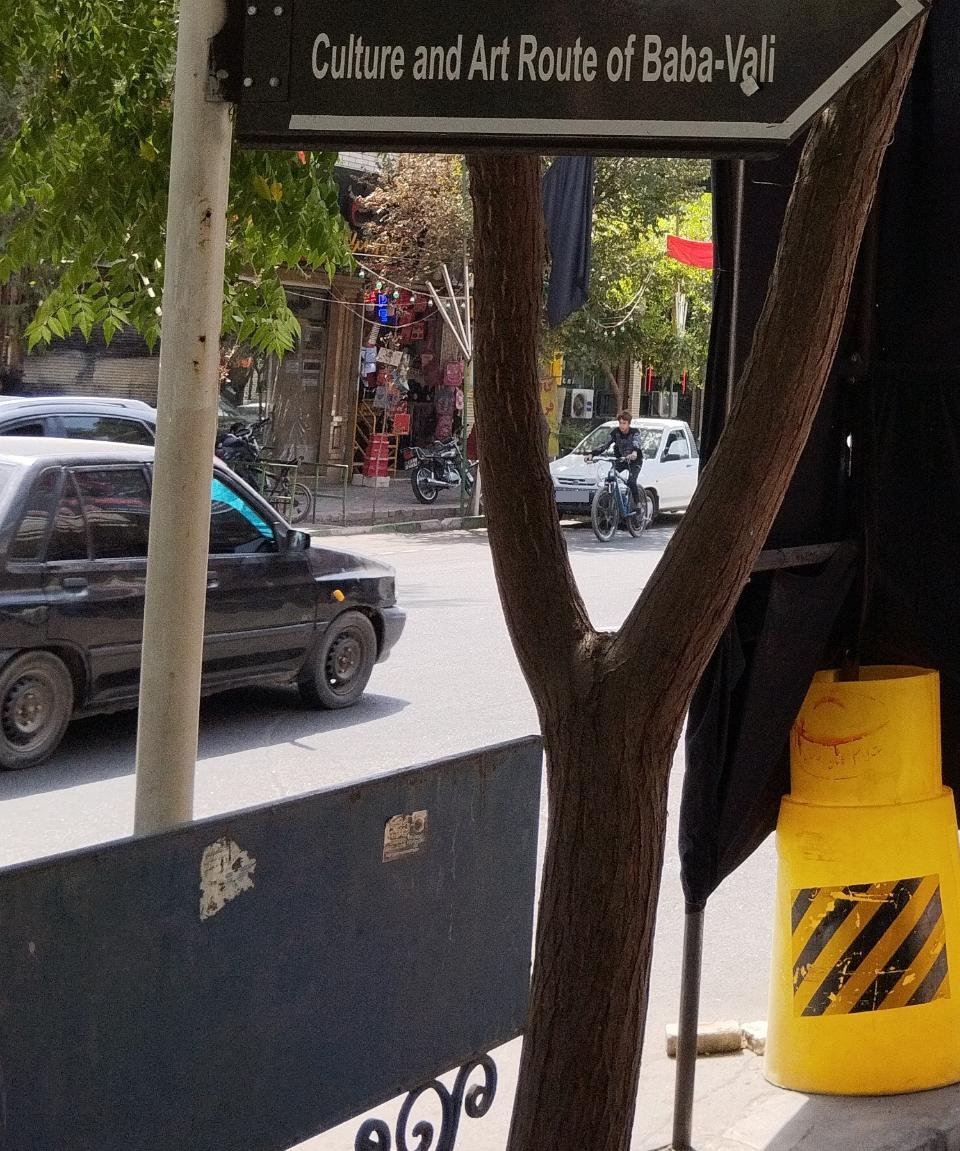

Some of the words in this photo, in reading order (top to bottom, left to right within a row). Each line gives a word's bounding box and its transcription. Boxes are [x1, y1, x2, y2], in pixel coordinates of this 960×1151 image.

[311, 32, 405, 80] Culture
[412, 34, 463, 80] and
[467, 34, 511, 82] Art
[517, 34, 598, 82] Route
[606, 34, 637, 83] of
[642, 34, 776, 84] Baba-Vali
